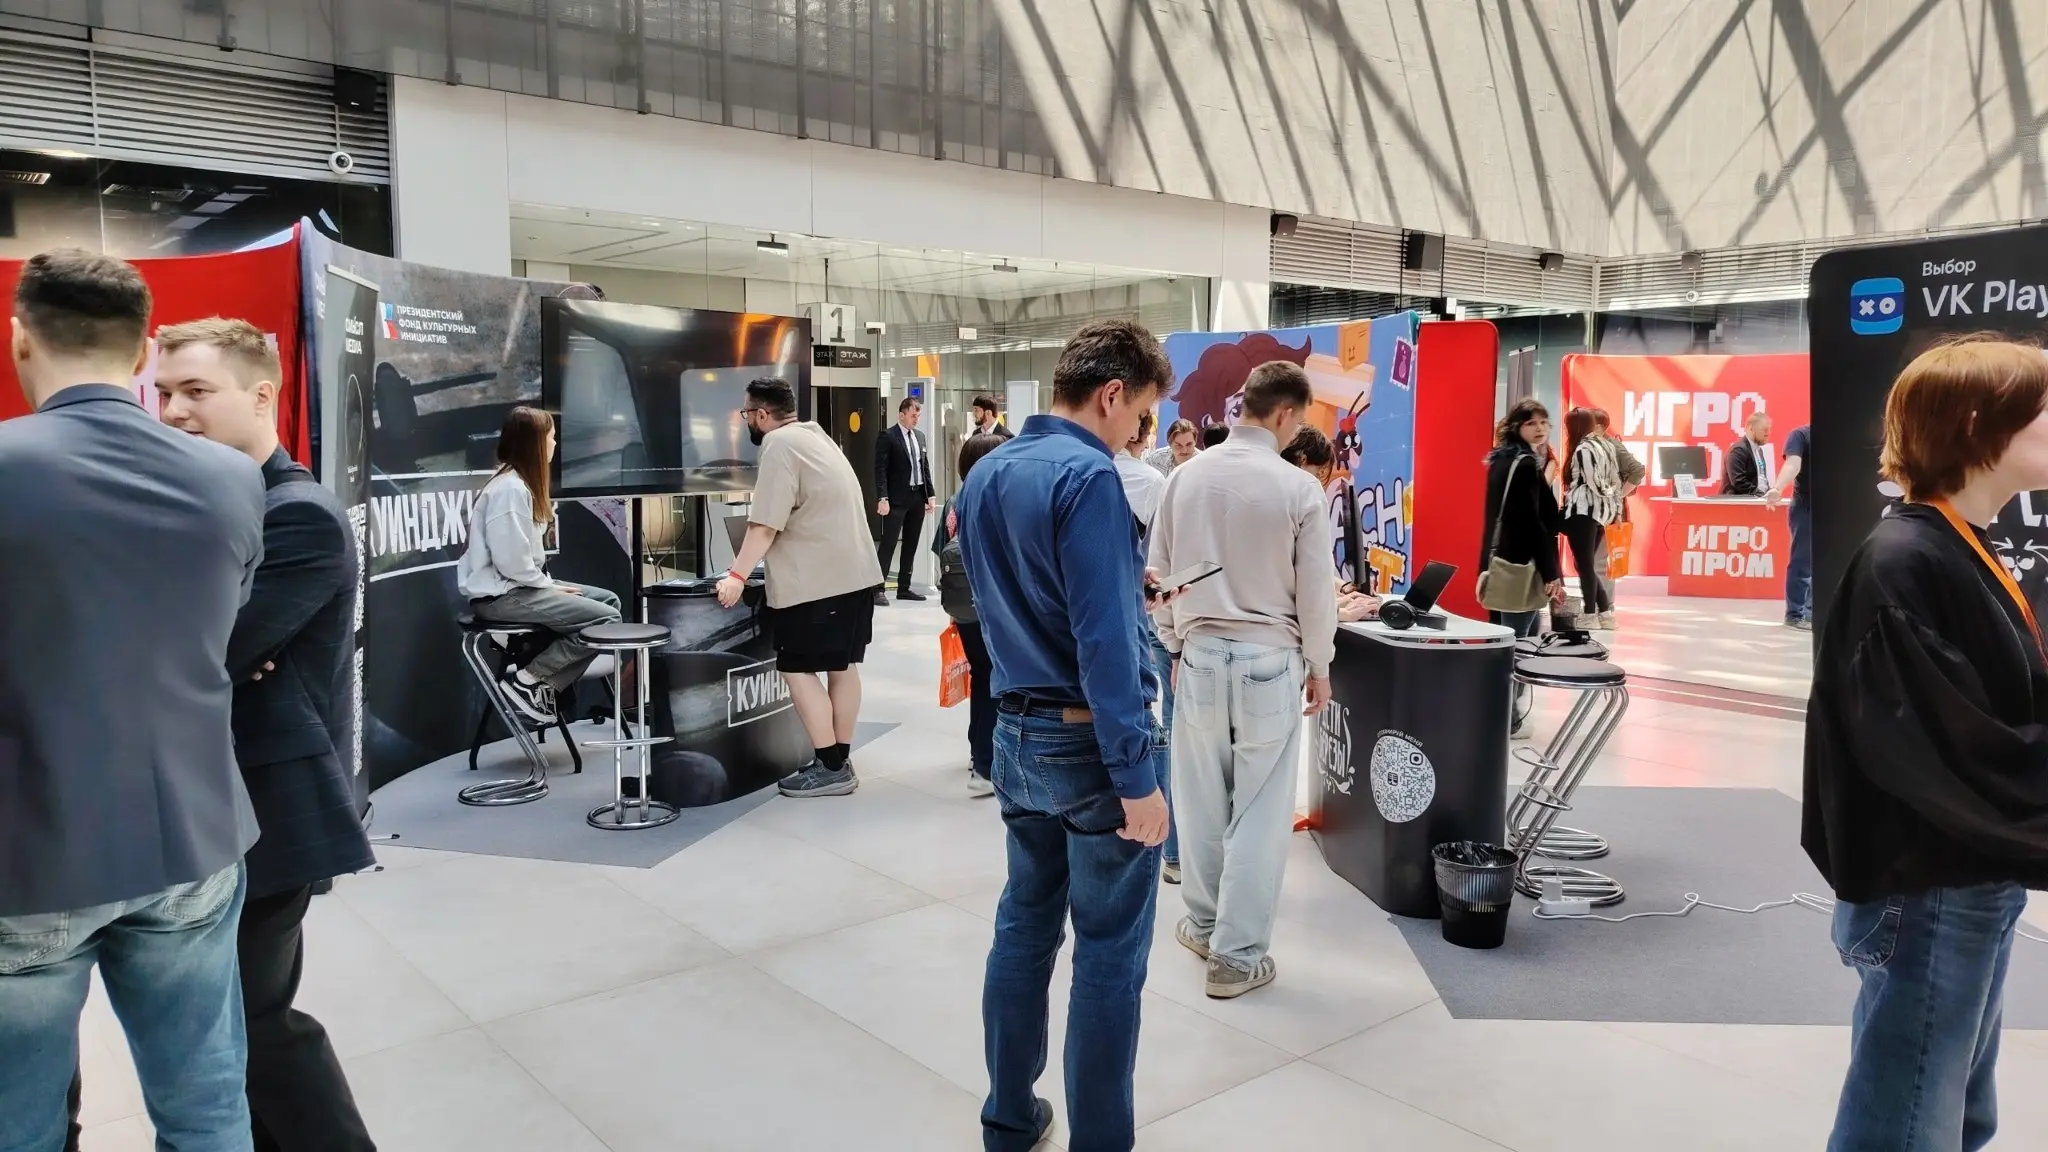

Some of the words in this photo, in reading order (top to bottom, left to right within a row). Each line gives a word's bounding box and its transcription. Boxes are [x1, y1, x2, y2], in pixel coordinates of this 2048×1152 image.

[1922, 258, 1976, 276] Выбор
[1922, 282, 1975, 317] VK
[1983, 279, 2048, 318] Play
[396, 305, 464, 321] ПРЕЗИДЕНТСКИЙ
[398, 319, 422, 330] ФОНД
[422, 321, 477, 334] КУЛЬТУРНЫХ
[830, 307, 845, 343] 1
[400, 331, 448, 344] ИНИЦИАТИВ
[840, 350, 868, 360] ЭТАЖ
[1623, 390, 1766, 437] ИГРО
[370, 488, 481, 558] УИНДЖ
[1687, 524, 1769, 551] ИГРО
[1681, 551, 1775, 578] ПРОМ
[736, 669, 791, 713] КУИНД
